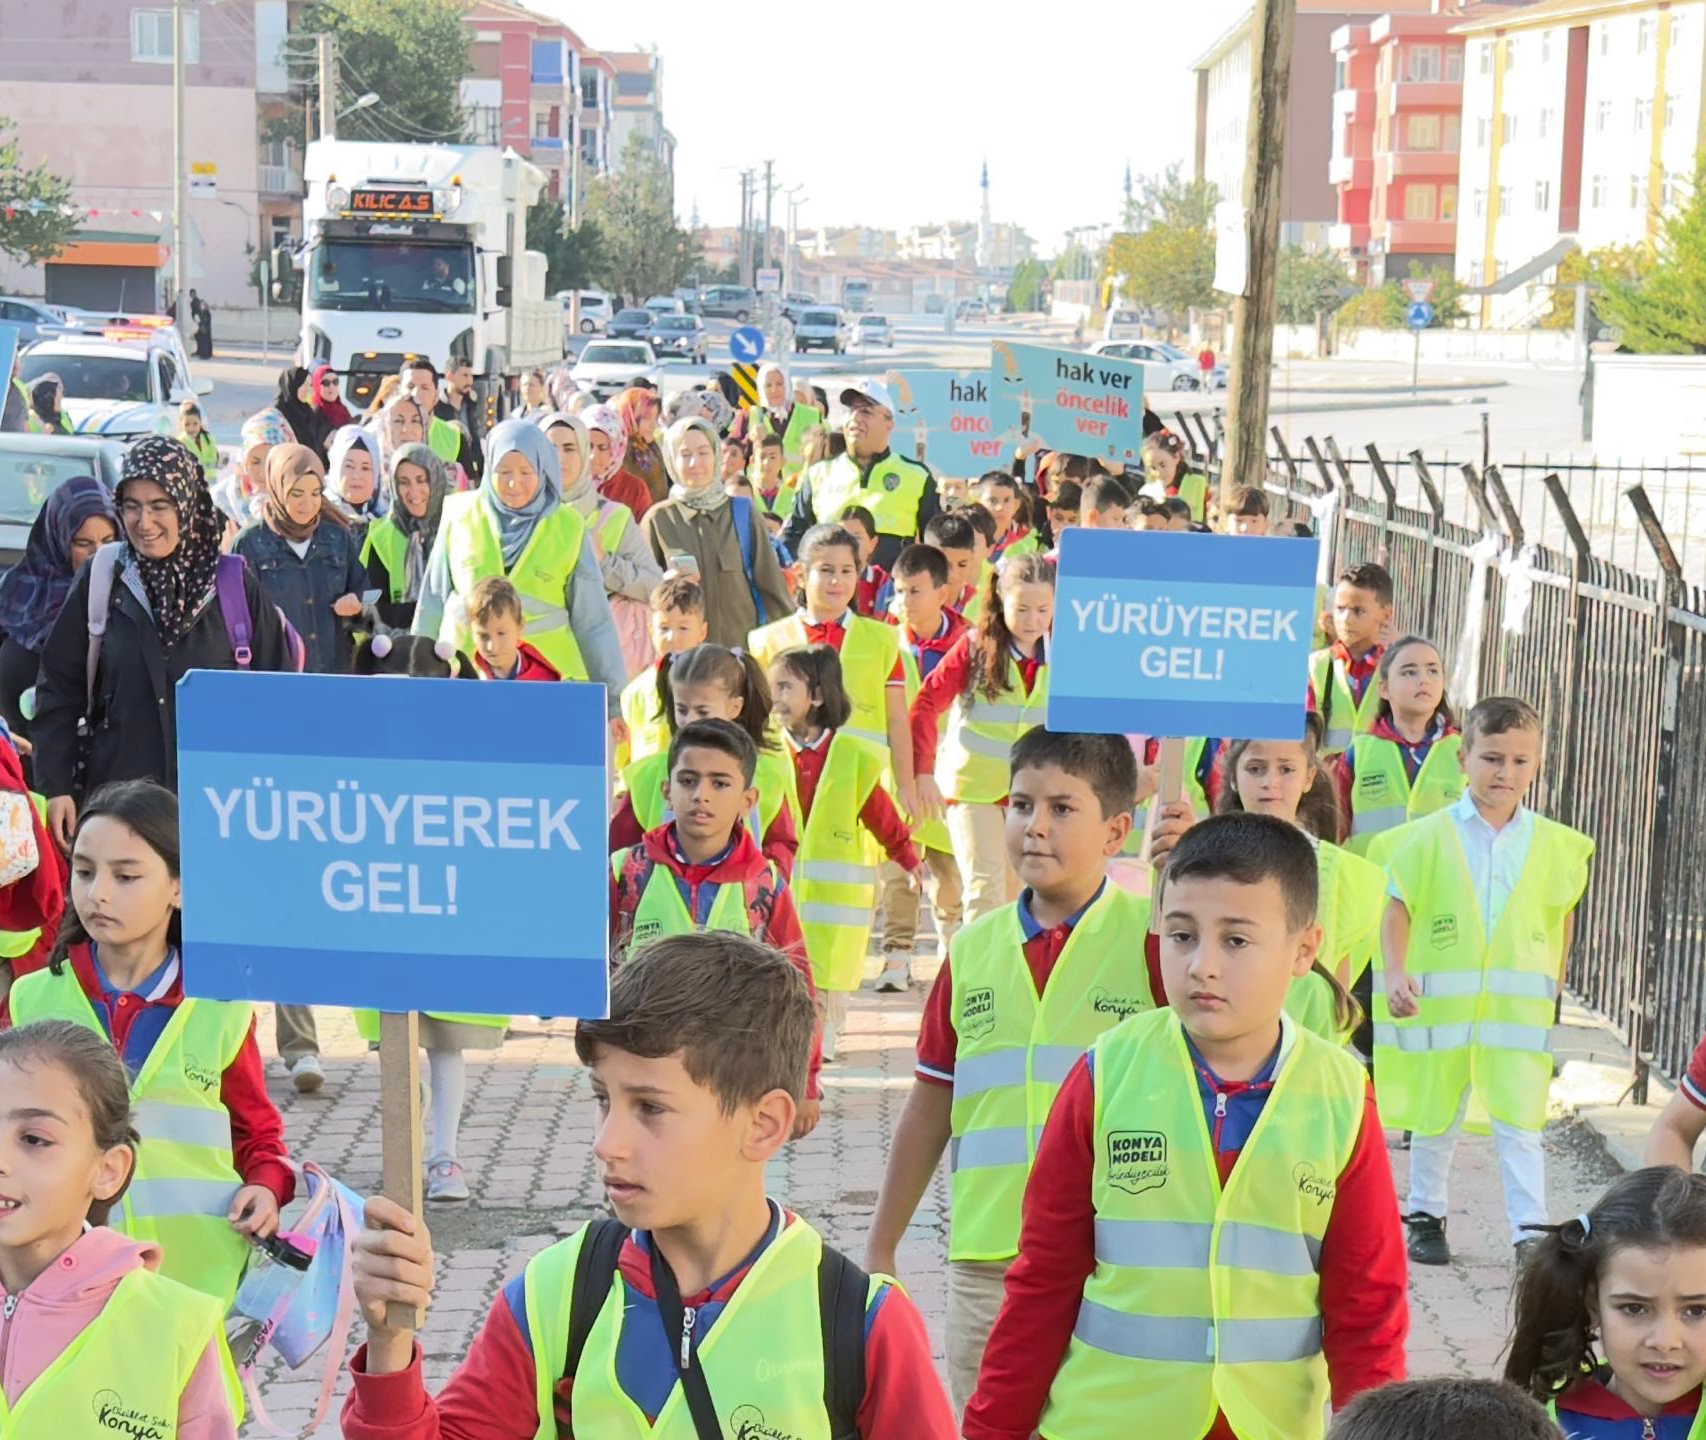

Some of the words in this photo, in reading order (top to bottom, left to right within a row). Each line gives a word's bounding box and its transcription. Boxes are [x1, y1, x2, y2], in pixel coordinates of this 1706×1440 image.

[1056, 358, 1094, 384] hak
[1099, 371, 1133, 390] ver
[949, 380, 987, 402] hak
[1055, 387, 1130, 419] öncelik
[1076, 416, 1109, 437] ver
[969, 437, 1004, 458] ver
[1071, 593, 1298, 642] YÜRÜYEREK
[1139, 646, 1225, 681] GEL!
[203, 777, 581, 851] YÜRÜYEREK
[321, 861, 458, 916] GEL!
[1112, 1136, 1163, 1151] KONYA
